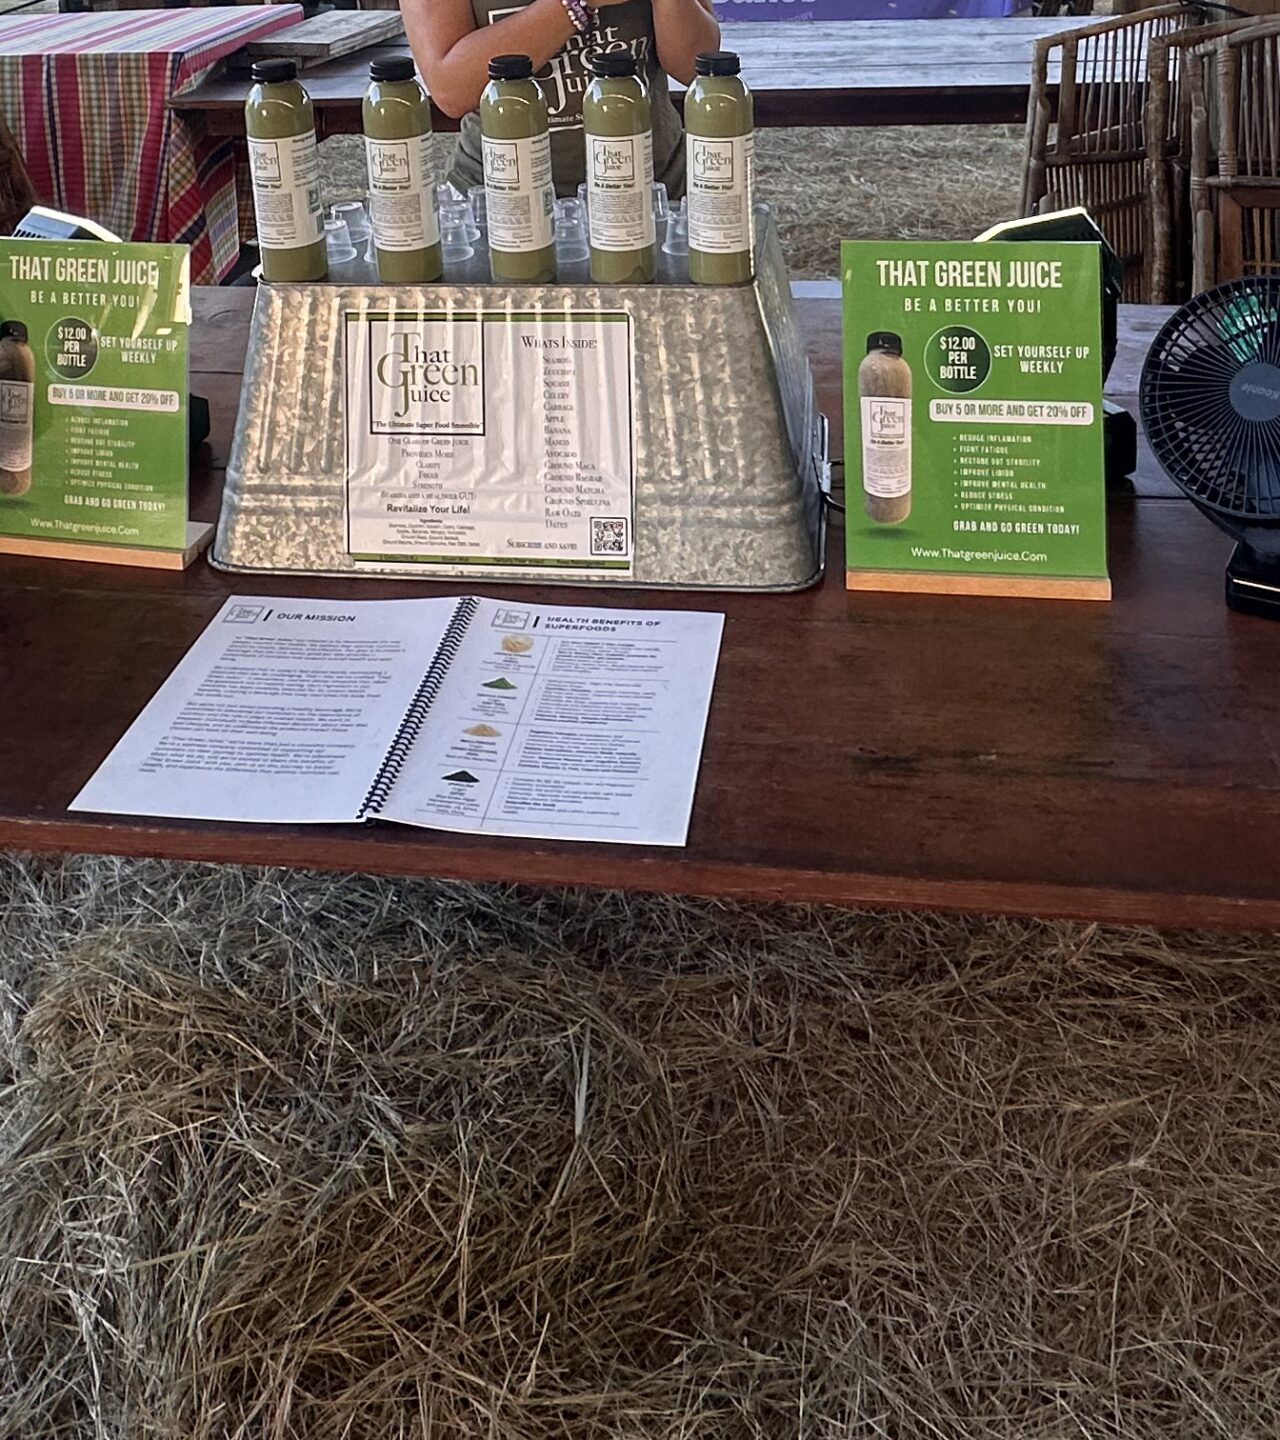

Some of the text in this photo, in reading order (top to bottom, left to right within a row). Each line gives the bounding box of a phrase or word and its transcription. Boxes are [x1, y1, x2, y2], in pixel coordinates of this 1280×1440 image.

[10, 255, 158, 286] THAT GREEN JUICE
[876, 260, 1062, 289] THAT GREEN JUICE
[905, 297, 1040, 313] BE A BETTER YOU!
[58, 326, 86, 340] $12.00
[64, 341, 79, 353] PER
[390, 332, 451, 363] That
[940, 336, 975, 351] $12.00
[949, 351, 967, 365] PER
[994, 344, 1089, 359] SET YOURSELF UP
[57, 353, 86, 367] BOTTLE
[1020, 360, 1063, 374] WEEKLY
[377, 352, 479, 388] Green
[940, 365, 976, 380] BOTTLE
[394, 366, 451, 417] Juice
[936, 402, 1087, 419] BUY 5 OR MORE AND GET 20% OFF
[387, 503, 470, 515] Revitalize Your Life!
[277, 612, 356, 622] OUR MISSION
